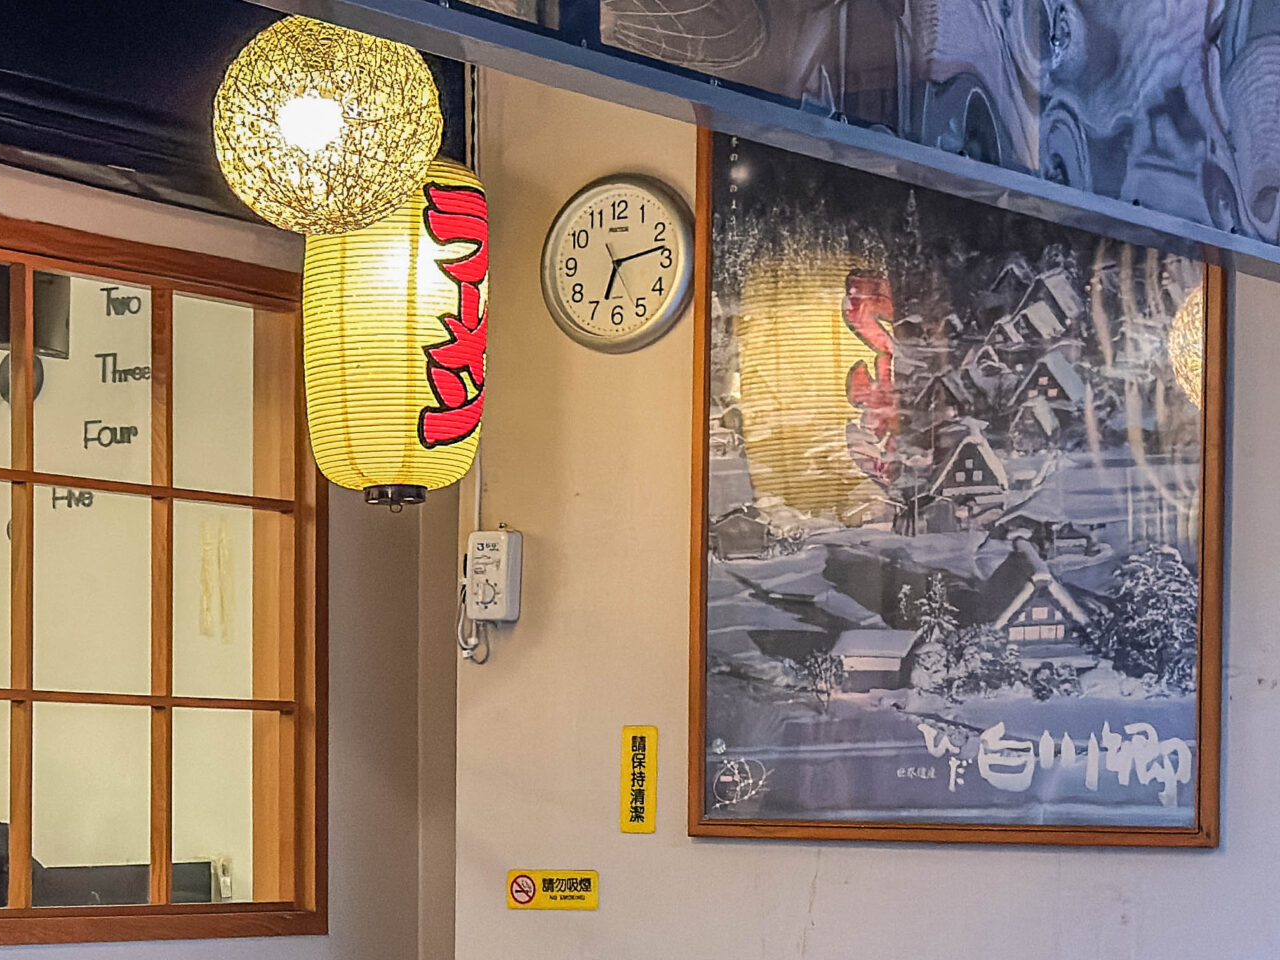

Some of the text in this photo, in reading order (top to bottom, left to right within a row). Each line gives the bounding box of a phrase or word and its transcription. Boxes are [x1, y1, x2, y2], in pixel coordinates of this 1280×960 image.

[589, 210, 603, 229] 11
[611, 200, 628, 220] 12
[640, 204, 645, 224] 1
[572, 230, 589, 249] 10
[654, 222, 666, 242] 2
[565, 258, 577, 277] 9
[660, 248, 672, 268] 3
[572, 283, 584, 303] 8
[652, 277, 664, 296] 4
[100, 287, 142, 316] Two
[589, 301, 600, 320] 7
[635, 297, 646, 317] 5
[611, 305, 623, 325] 6
[94, 352, 151, 384] Three
[83, 420, 138, 449] Four
[629, 735, 646, 823] 請保持清潔
